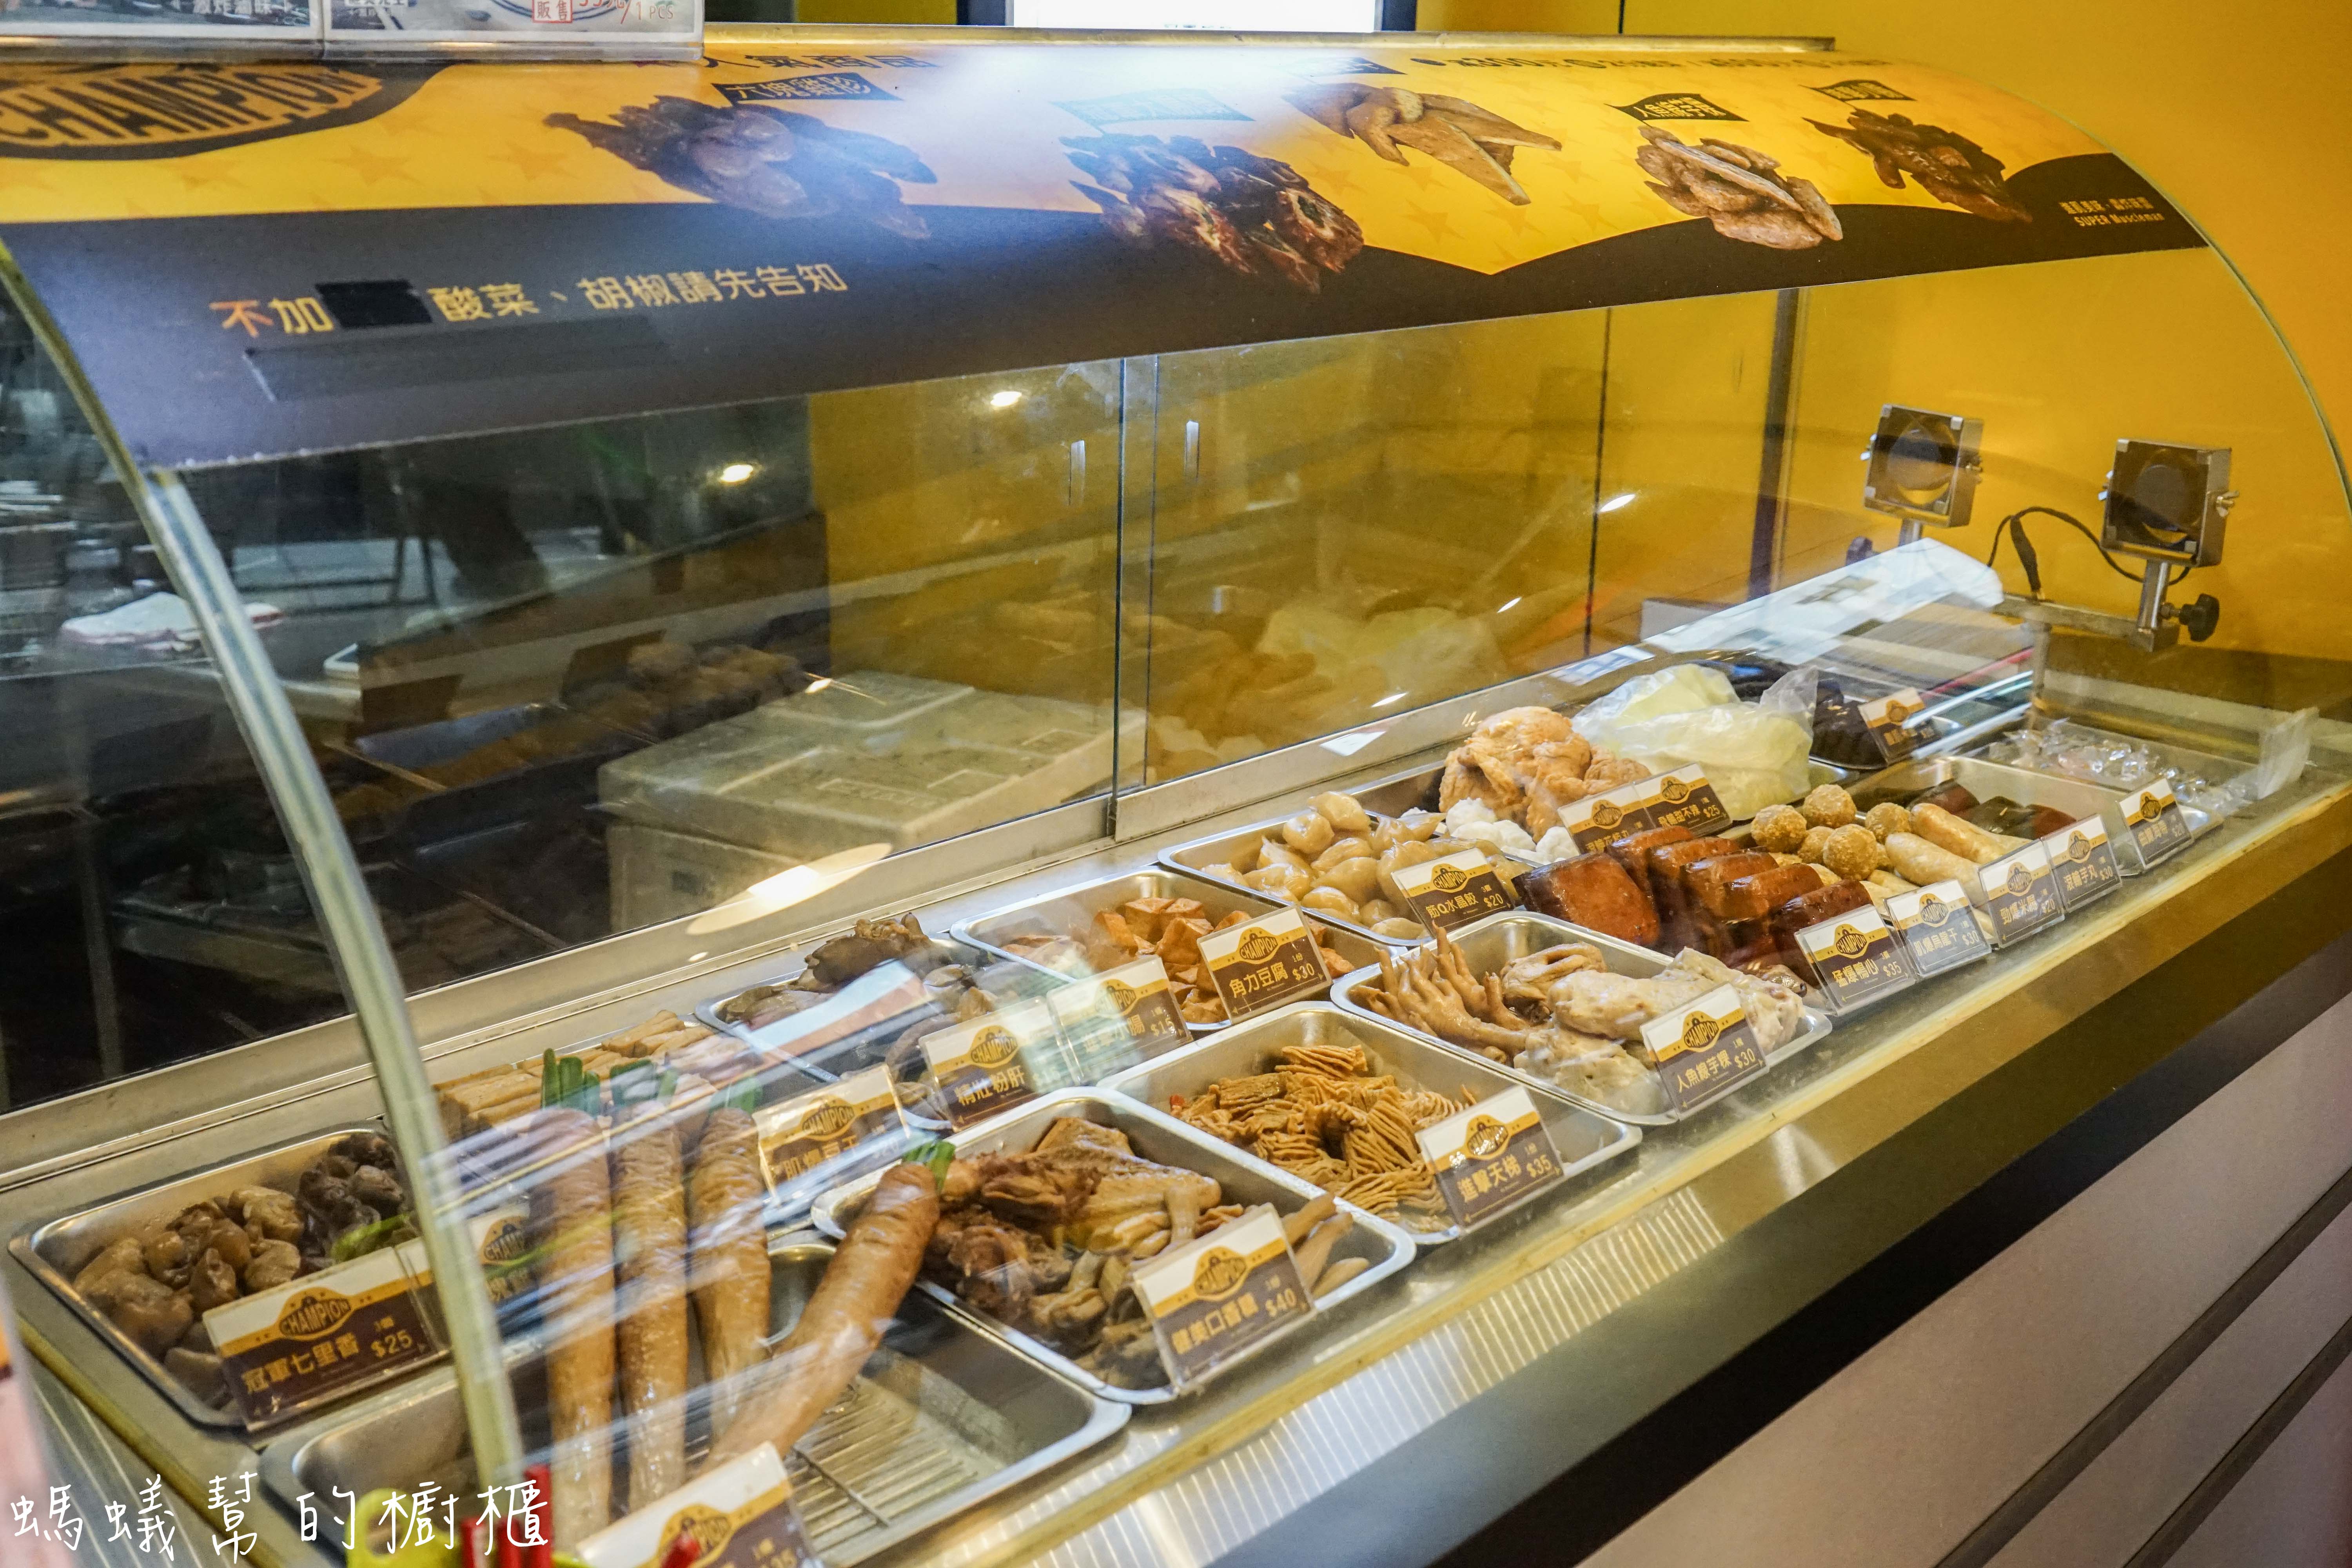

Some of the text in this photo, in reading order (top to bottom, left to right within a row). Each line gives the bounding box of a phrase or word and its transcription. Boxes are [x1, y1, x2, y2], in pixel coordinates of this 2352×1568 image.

[537, 1, 568, 21] 販售
[649, 5, 674, 19] PCS
[703, 55, 940, 68] 人氣商品
[2075, 215, 2111, 227] SUPER
[210, 263, 849, 338] 不加 酸菜、胡椒請先告知
[1704, 805, 1720, 818] $25
[1434, 871, 1467, 889] CHAMPION
[1426, 893, 1479, 918] 筋Q水晶餃
[1483, 893, 1504, 908] $20
[1240, 936, 1278, 960] CHAMPION
[1836, 933, 1867, 955] CHAMPION
[1962, 931, 1979, 946] $30
[1229, 962, 1289, 998] 角力豆腐
[1292, 963, 1315, 981] $30
[1831, 959, 1879, 987] 猛爆鴨心
[1884, 961, 1902, 977] $35
[1685, 1021, 1719, 1047] CHAMPION
[971, 1035, 1017, 1067] CHAMPION
[1734, 1048, 1755, 1069] $30
[802, 1106, 854, 1134] CHAMPION
[1526, 1154, 1553, 1178] $35
[280, 1298, 350, 1335] CHAMPION
[371, 1330, 413, 1358] $25
